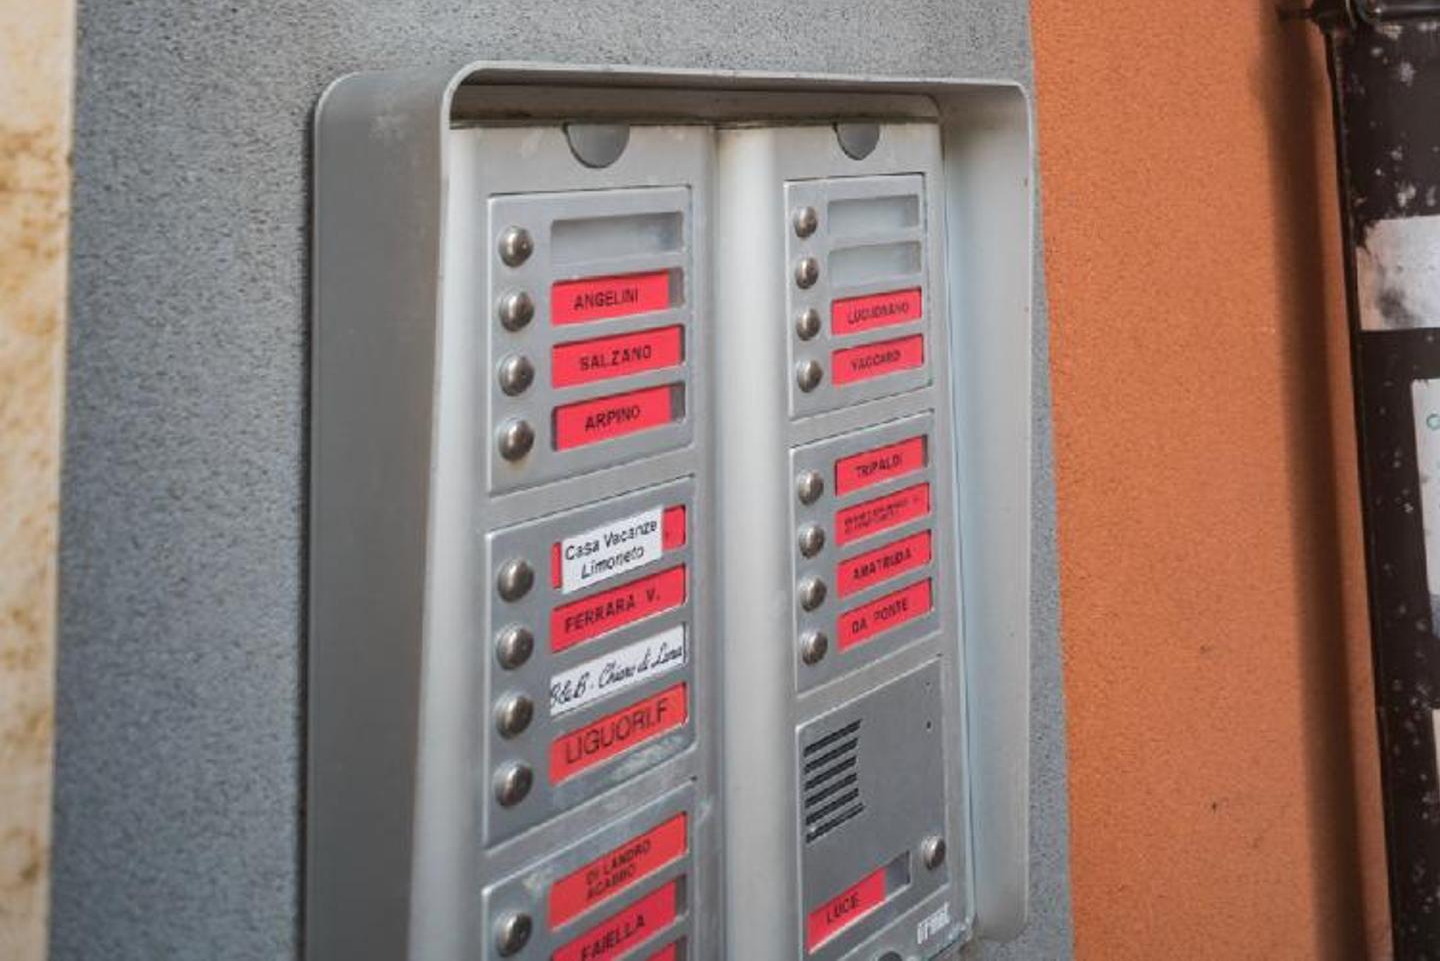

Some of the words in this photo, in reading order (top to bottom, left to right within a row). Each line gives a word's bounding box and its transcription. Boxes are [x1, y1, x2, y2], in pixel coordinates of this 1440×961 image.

[573, 287, 639, 310] ANGELINI
[579, 345, 653, 371] SALZANO
[584, 405, 641, 432] ARPINO
[565, 539, 600, 561] Casa
[603, 520, 658, 549] Vacanze
[581, 546, 645, 580] Limoneto
[564, 594, 636, 634] FERRARA
[644, 587, 661, 602] V.
[851, 618, 868, 634] DA
[825, 891, 859, 926] LUCE
